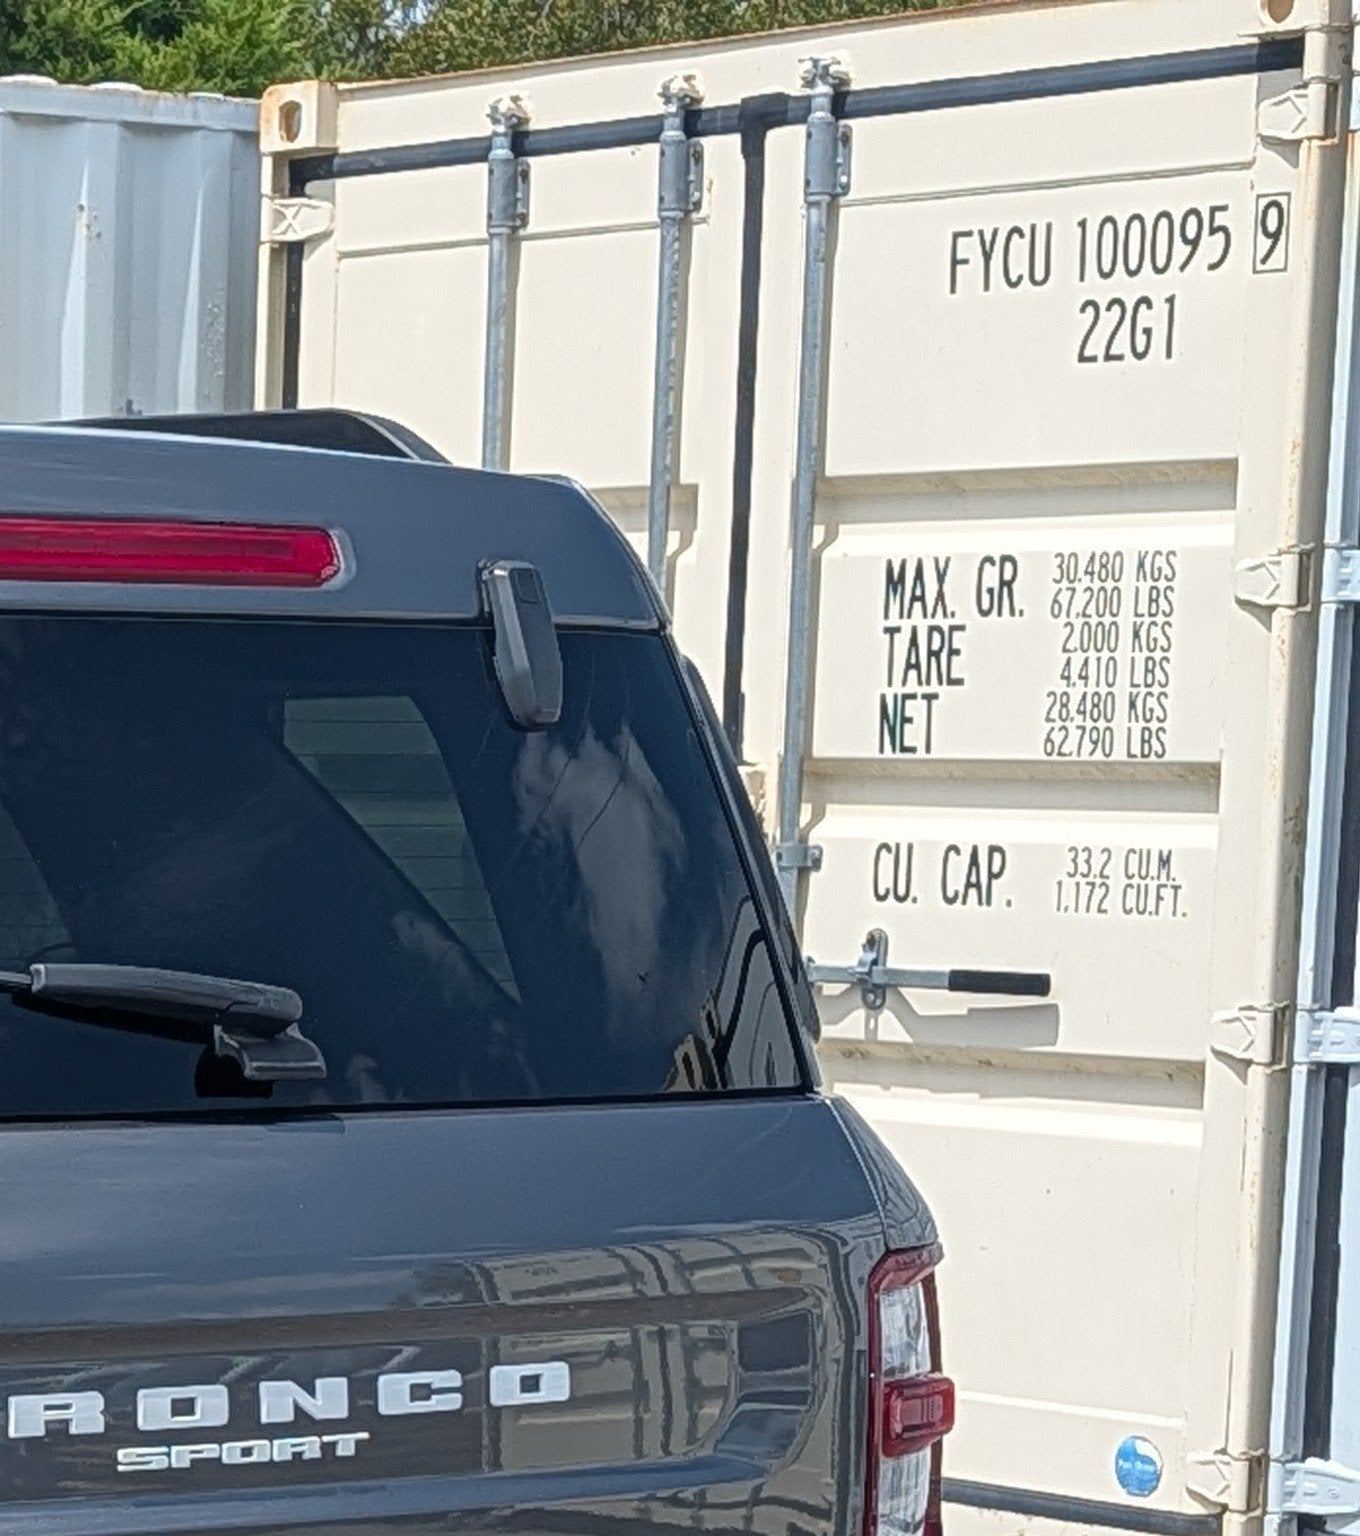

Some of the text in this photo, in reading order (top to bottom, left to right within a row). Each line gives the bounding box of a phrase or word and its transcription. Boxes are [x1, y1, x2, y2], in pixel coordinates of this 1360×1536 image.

[949, 198, 1285, 295] FYCU 100095 9
[1077, 293, 1177, 363] 22G1
[1136, 550, 1177, 582] KGS
[883, 554, 1024, 621] MAX. GR.
[1133, 585, 1175, 618] LBS
[1130, 620, 1173, 653] KGS
[882, 624, 967, 688] TARE
[1129, 655, 1171, 688] LBS
[879, 691, 940, 755] NET
[1127, 691, 1169, 723] KGS
[1126, 725, 1167, 759] LBS
[872, 842, 1013, 908] CU. CAP.
[1124, 848, 1177, 882] CU.M.
[1122, 883, 1188, 917] CU.FT.
[116, 1431, 371, 1472] SPORT
